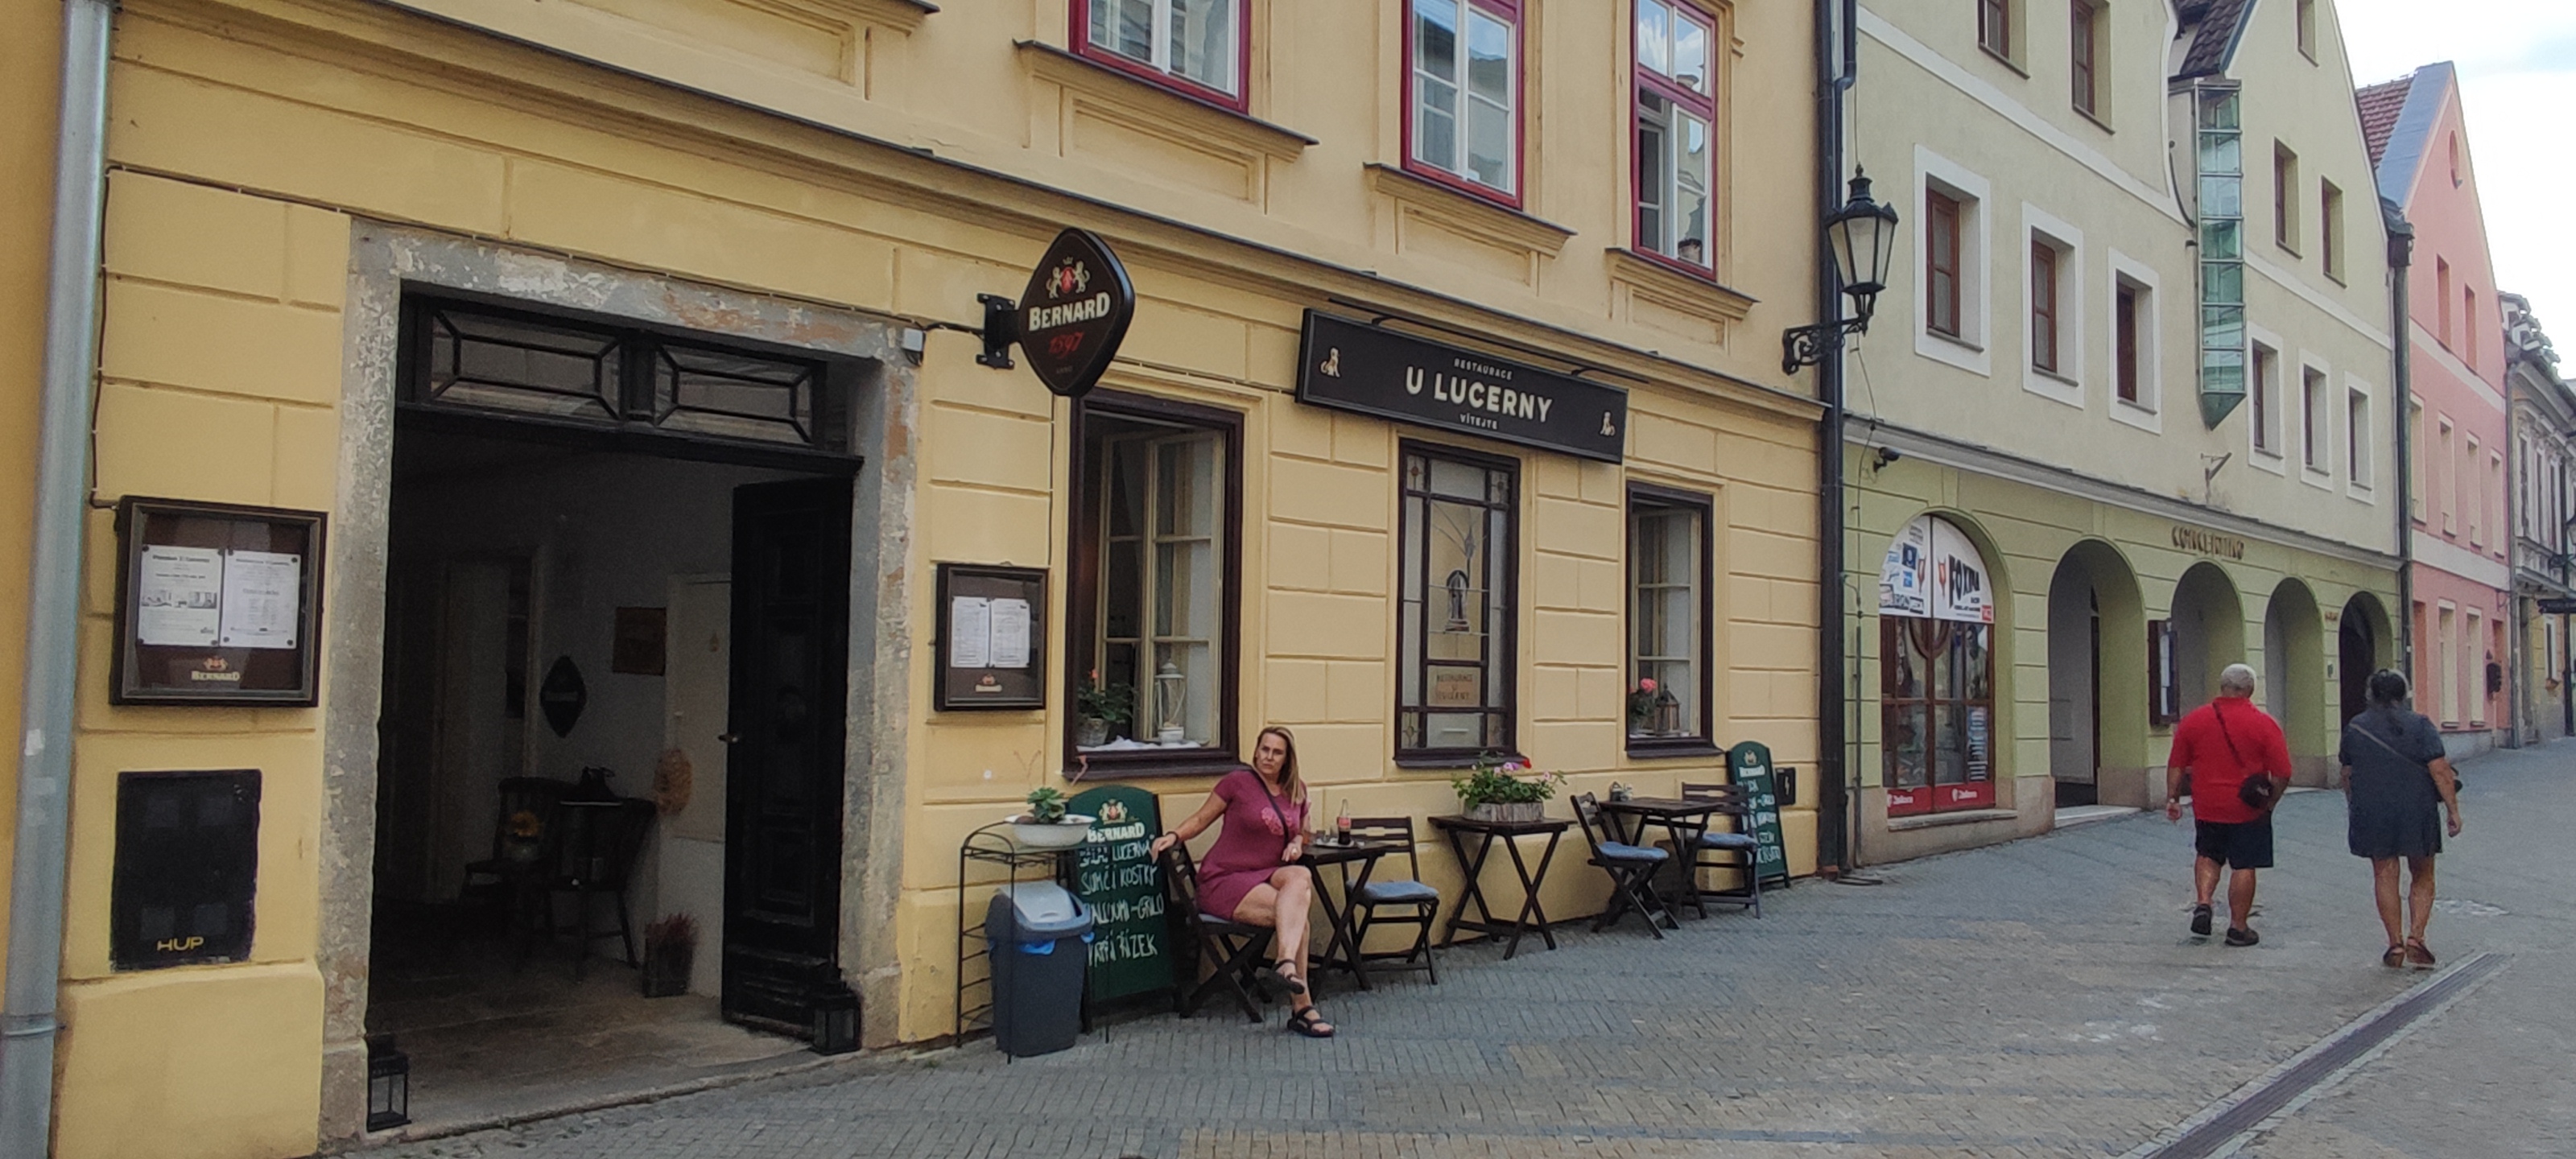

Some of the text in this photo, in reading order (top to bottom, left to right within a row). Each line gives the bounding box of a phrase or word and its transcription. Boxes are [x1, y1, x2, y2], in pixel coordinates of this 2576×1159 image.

[1029, 291, 1112, 332] BERNARD
[1048, 331, 1084, 359] 1597
[1453, 357, 1513, 382] RESTAURACE
[1406, 365, 1553, 423] U LUCERNY
[1459, 412, 1498, 430] VÍTEJTE
[1087, 822, 1145, 843] BERNARD
[1120, 864, 1158, 887] KOSTKY
[157, 936, 204, 951] HUP
